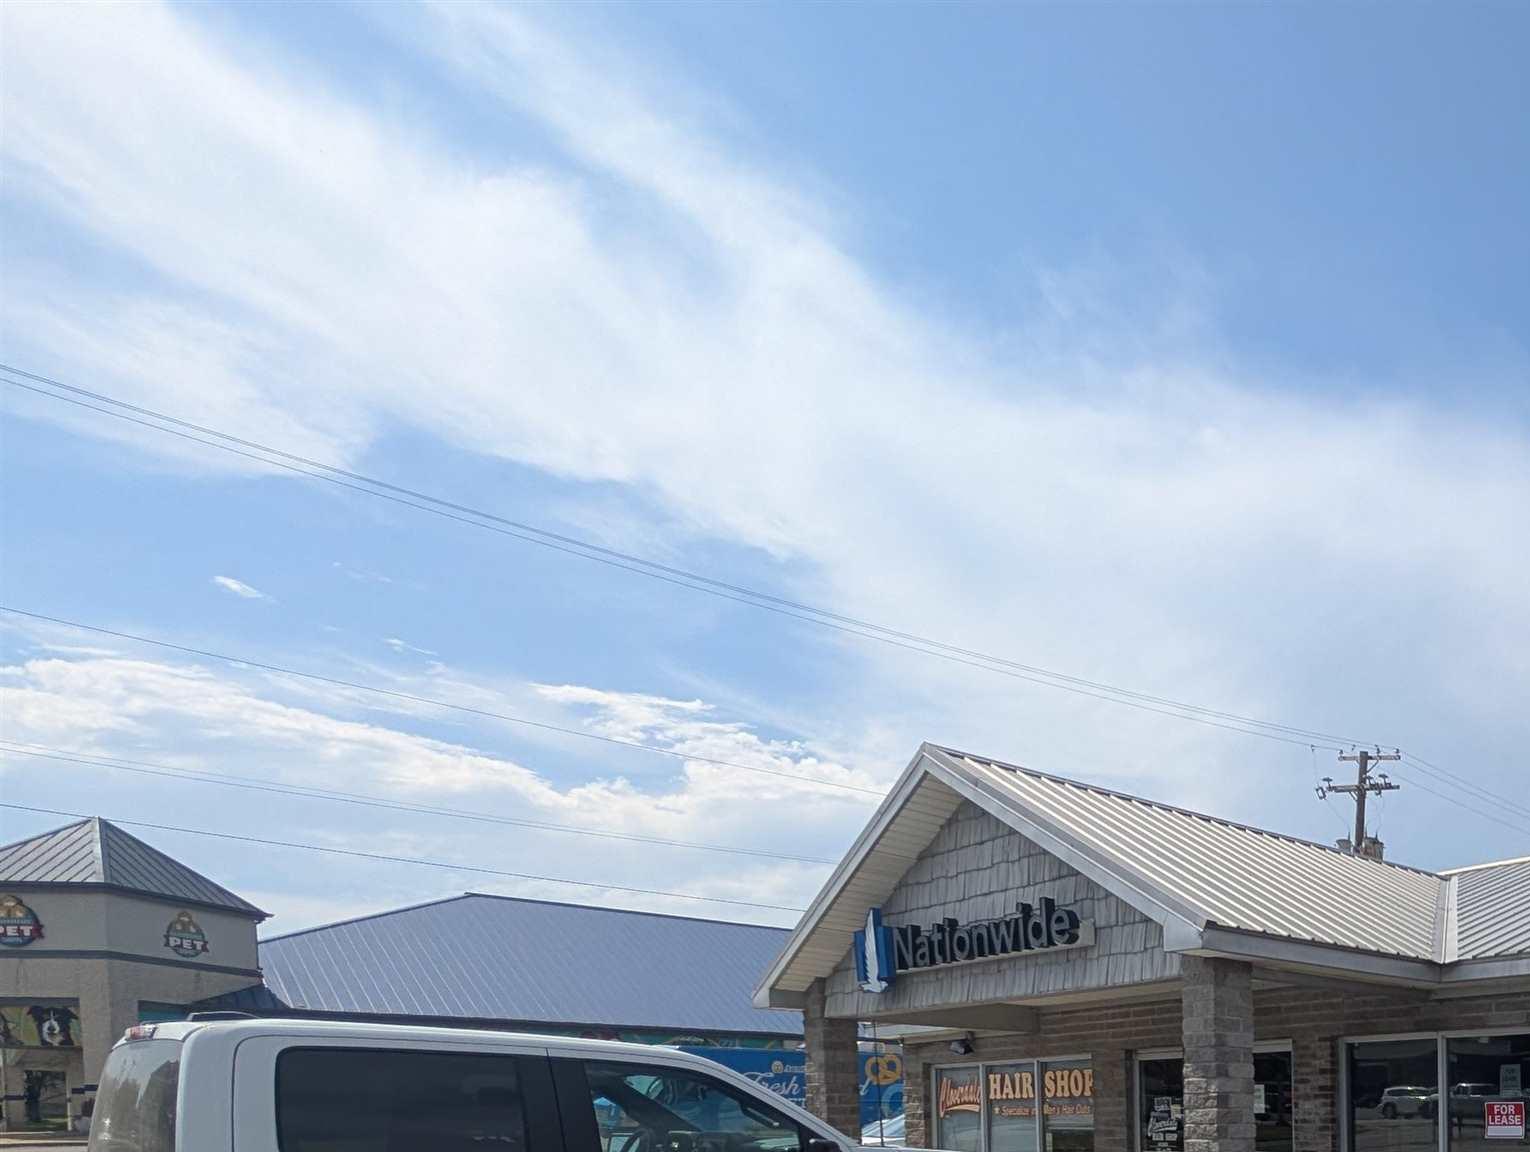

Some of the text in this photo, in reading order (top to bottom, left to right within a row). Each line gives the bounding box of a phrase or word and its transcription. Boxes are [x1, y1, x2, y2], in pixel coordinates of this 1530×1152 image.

[893, 897, 1081, 970] Nationwide
[169, 936, 204, 950] PET
[988, 1072, 1034, 1100] HAIR
[1493, 1104, 1516, 1115] FOR
[1488, 1114, 1522, 1126] LEASE
